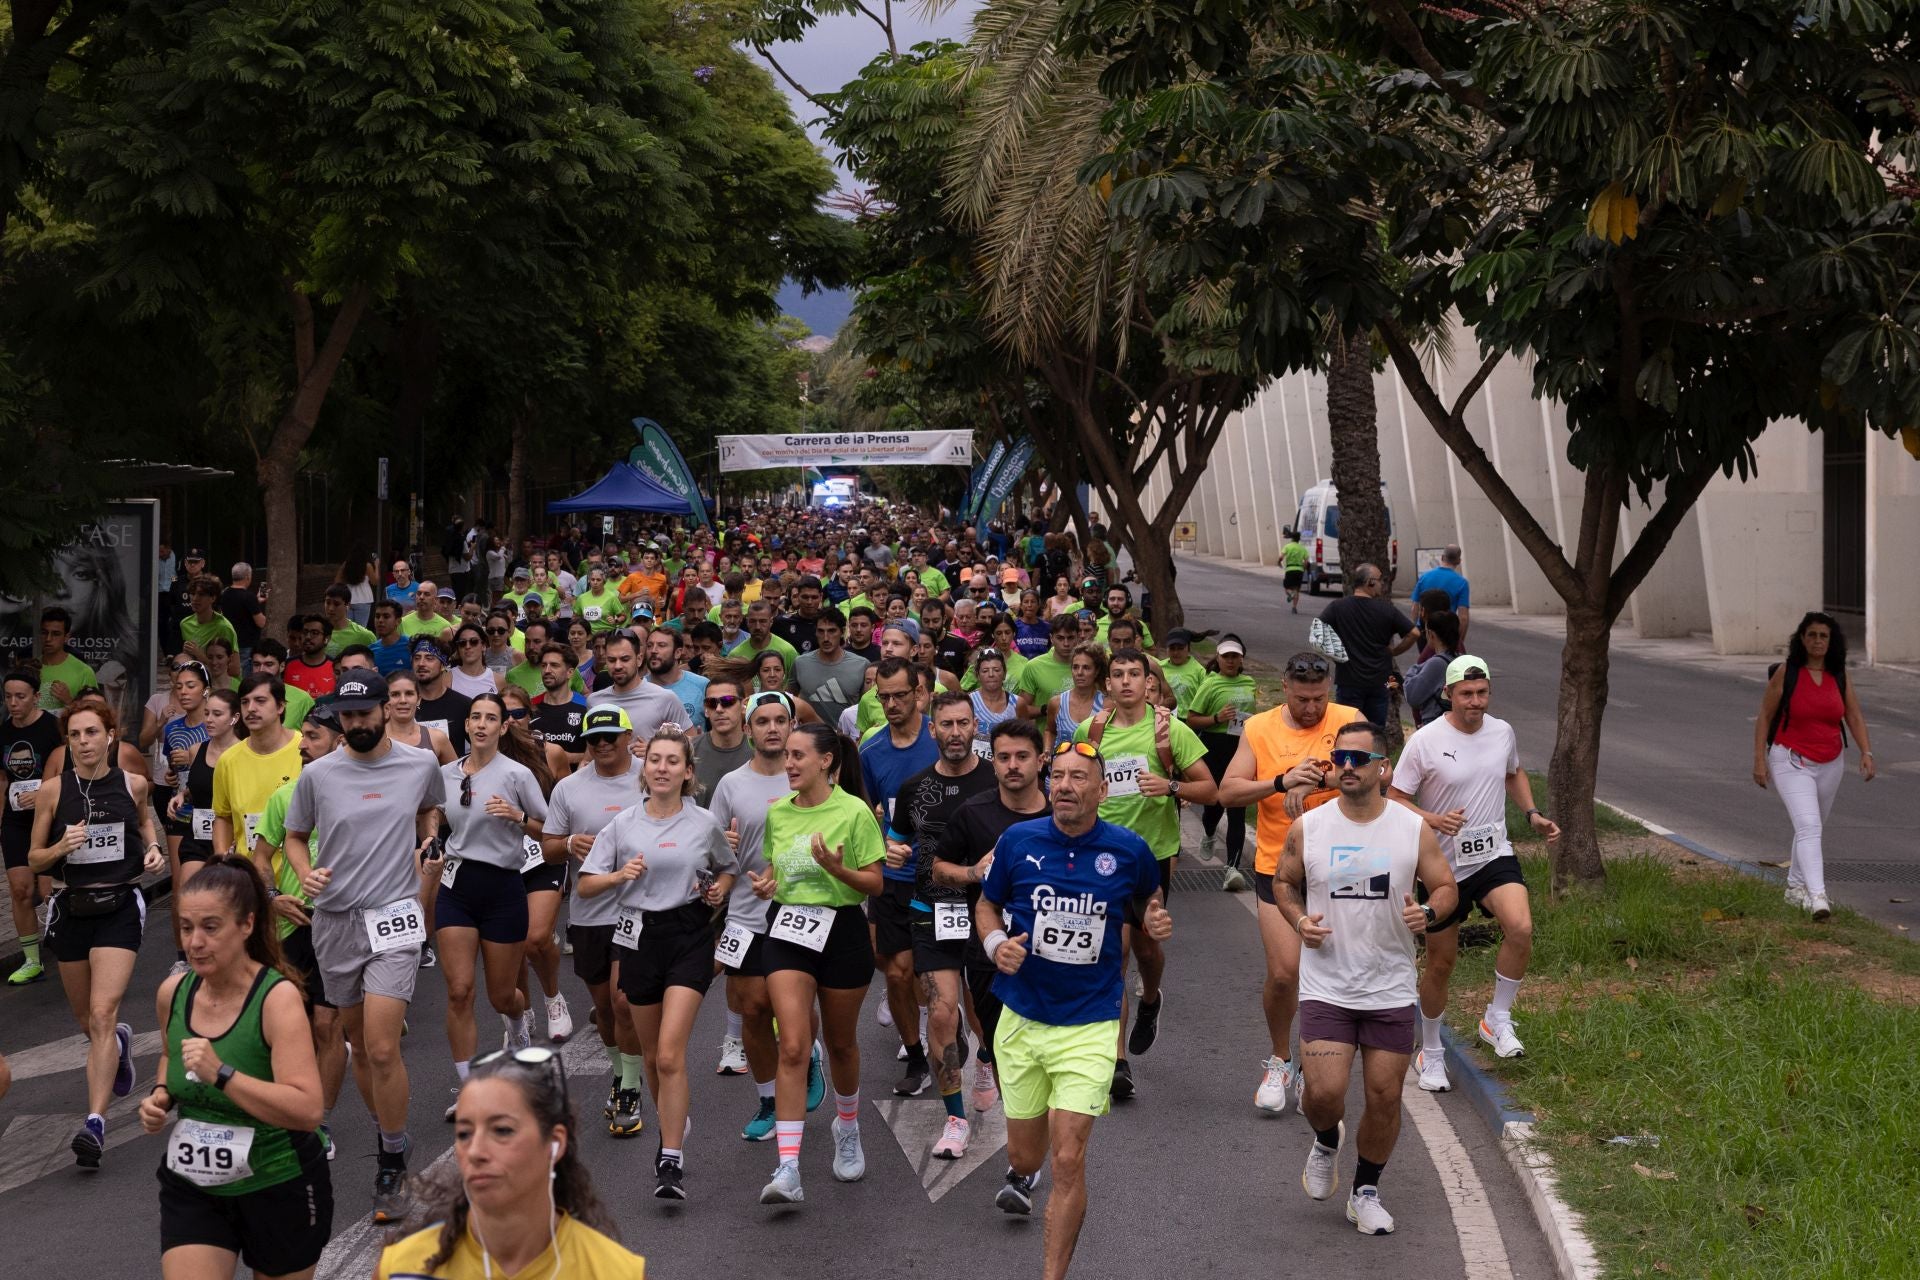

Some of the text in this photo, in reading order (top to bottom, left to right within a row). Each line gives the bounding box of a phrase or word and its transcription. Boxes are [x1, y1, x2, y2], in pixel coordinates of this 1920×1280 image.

[784, 434, 910, 446] Carrera de la Prensa
[978, 443, 1006, 491] Fundació
[67, 637, 120, 648] GLOSSY
[82, 651, 109, 660] RIZZ
[339, 681, 369, 696] SATISFY
[544, 733, 576, 742] Spotify
[1461, 836, 1494, 854] 861
[1030, 884, 1108, 915] famila
[376, 913, 419, 937] 698
[780, 911, 821, 934] 297
[1043, 927, 1093, 949] 673
[178, 1142, 233, 1169] 319
